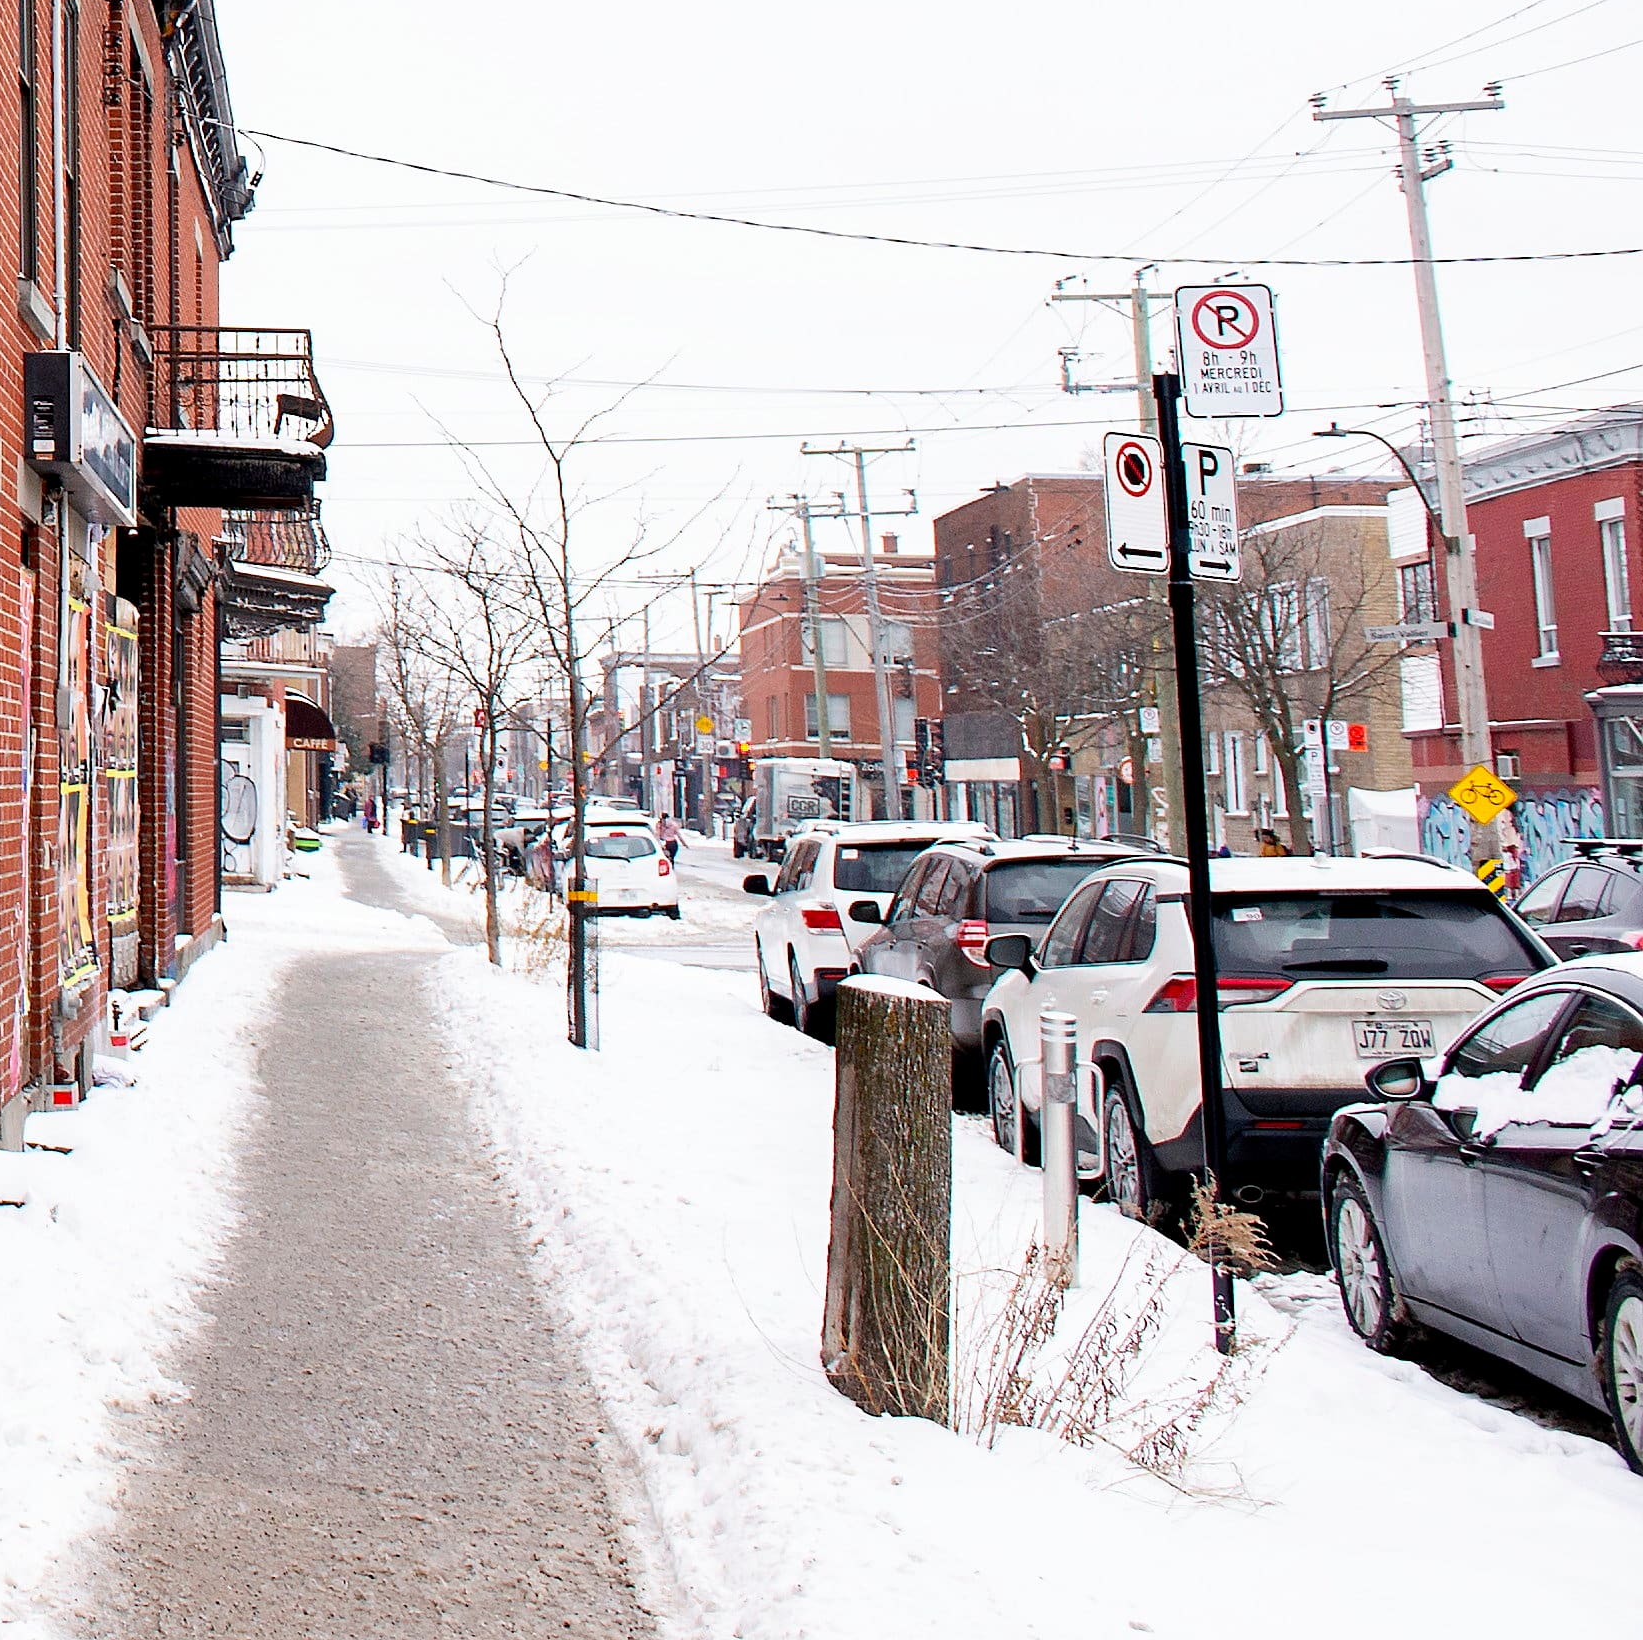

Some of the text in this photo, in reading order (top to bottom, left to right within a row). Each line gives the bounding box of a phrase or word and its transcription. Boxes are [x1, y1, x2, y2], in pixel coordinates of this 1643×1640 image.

[1202, 351, 1219, 366] 8h
[1239, 350, 1257, 365] 9h
[1200, 366, 1262, 380] MERCREDI
[1202, 382, 1230, 394] AVRIL
[1252, 381, 1272, 393] DEC
[1191, 500, 1231, 523] 60 min
[1359, 1029, 1388, 1049] J77
